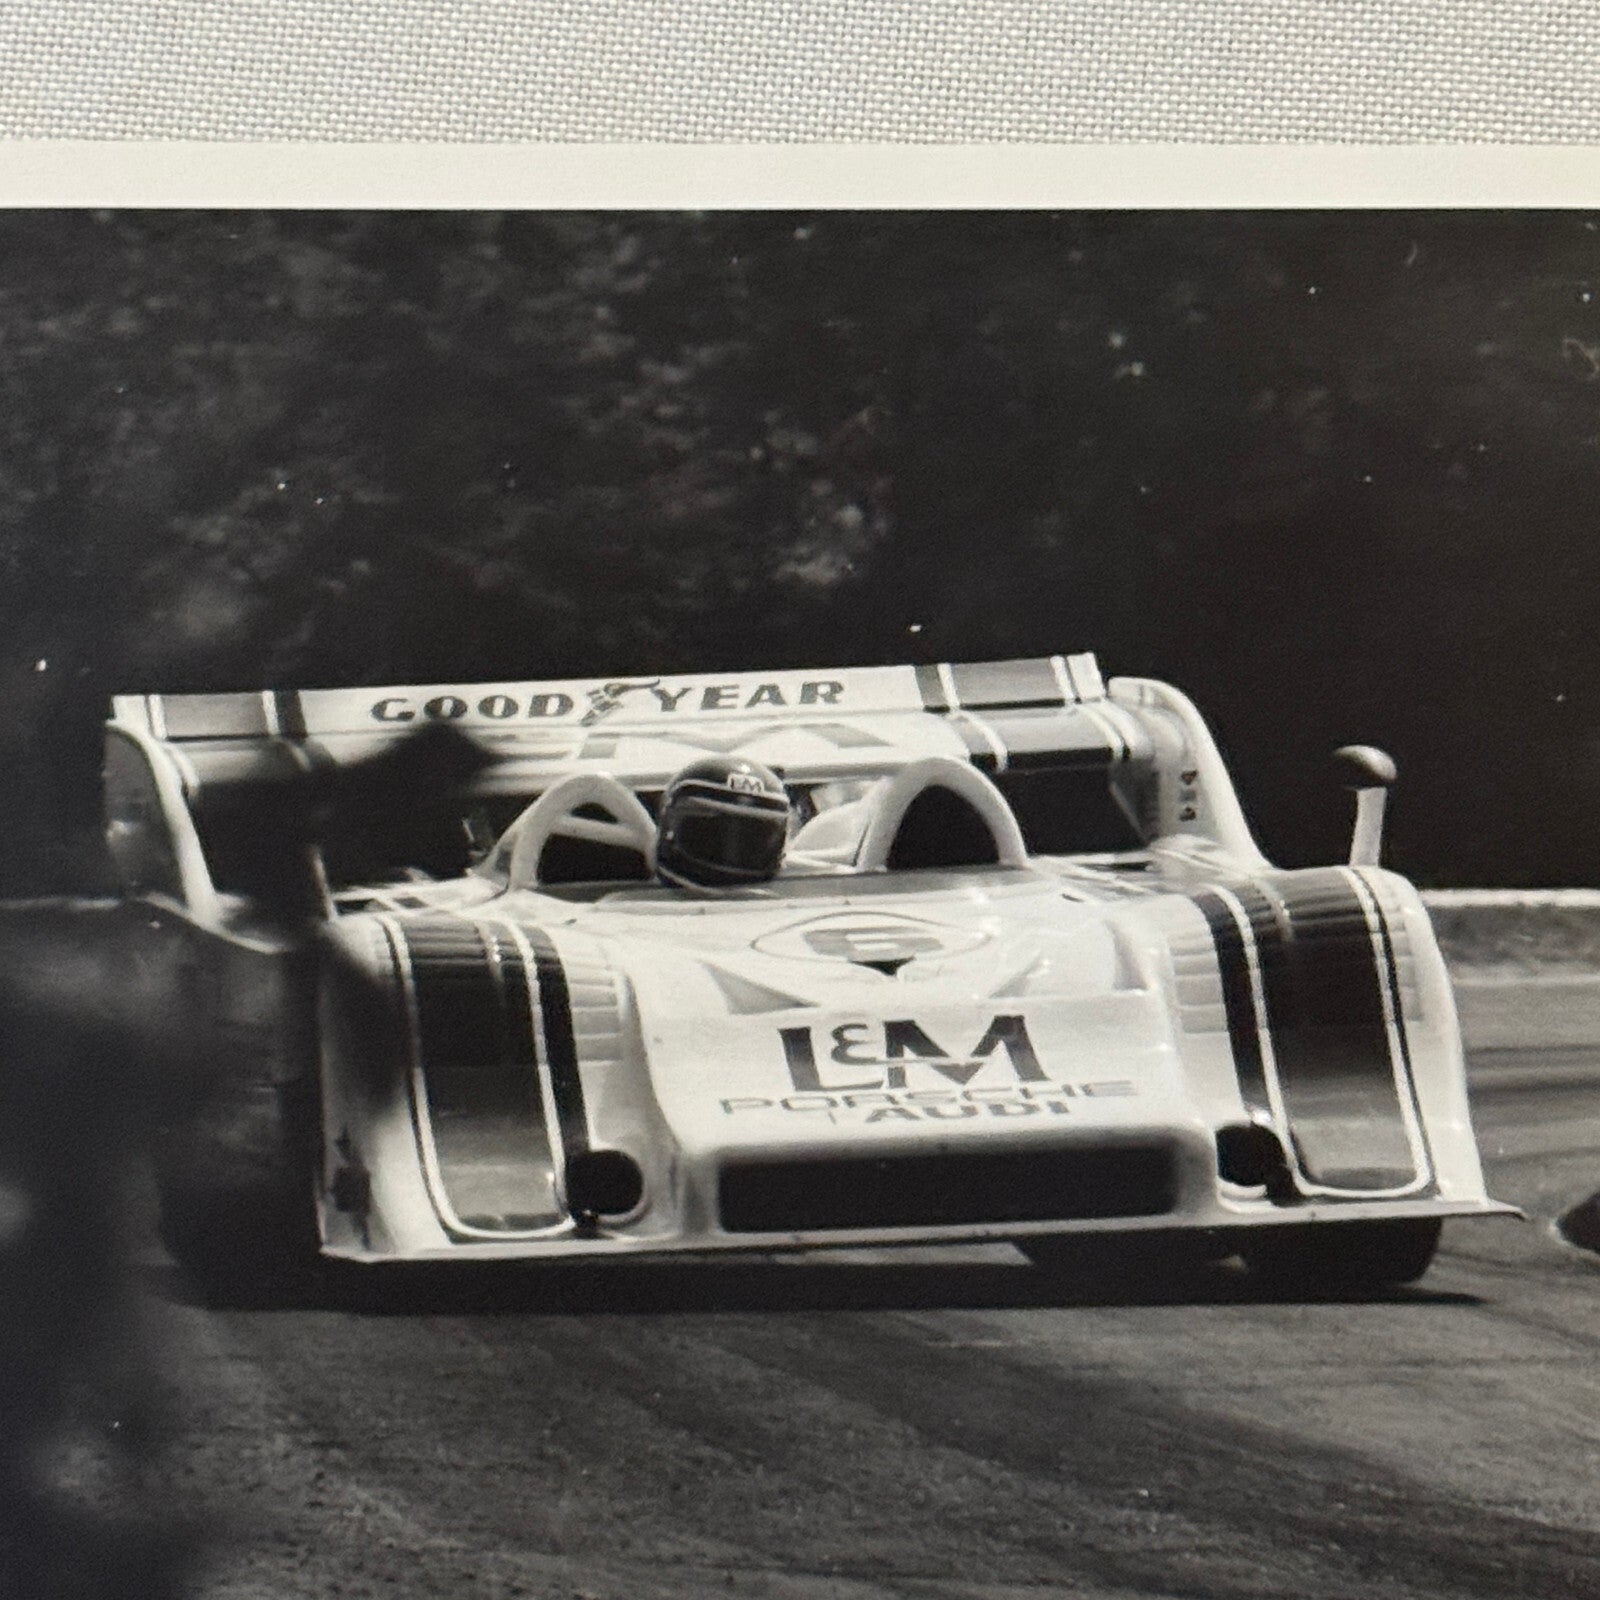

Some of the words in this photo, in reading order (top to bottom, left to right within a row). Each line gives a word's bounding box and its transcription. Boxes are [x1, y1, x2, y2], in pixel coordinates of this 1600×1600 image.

[371, 693, 575, 722] GOOD
[651, 680, 846, 712] YEAR
[729, 776, 763, 794] LM
[778, 1014, 1051, 1092] L&M
[718, 1079, 1138, 1116] PORSCHE
[864, 1099, 1071, 1123] AUDI
